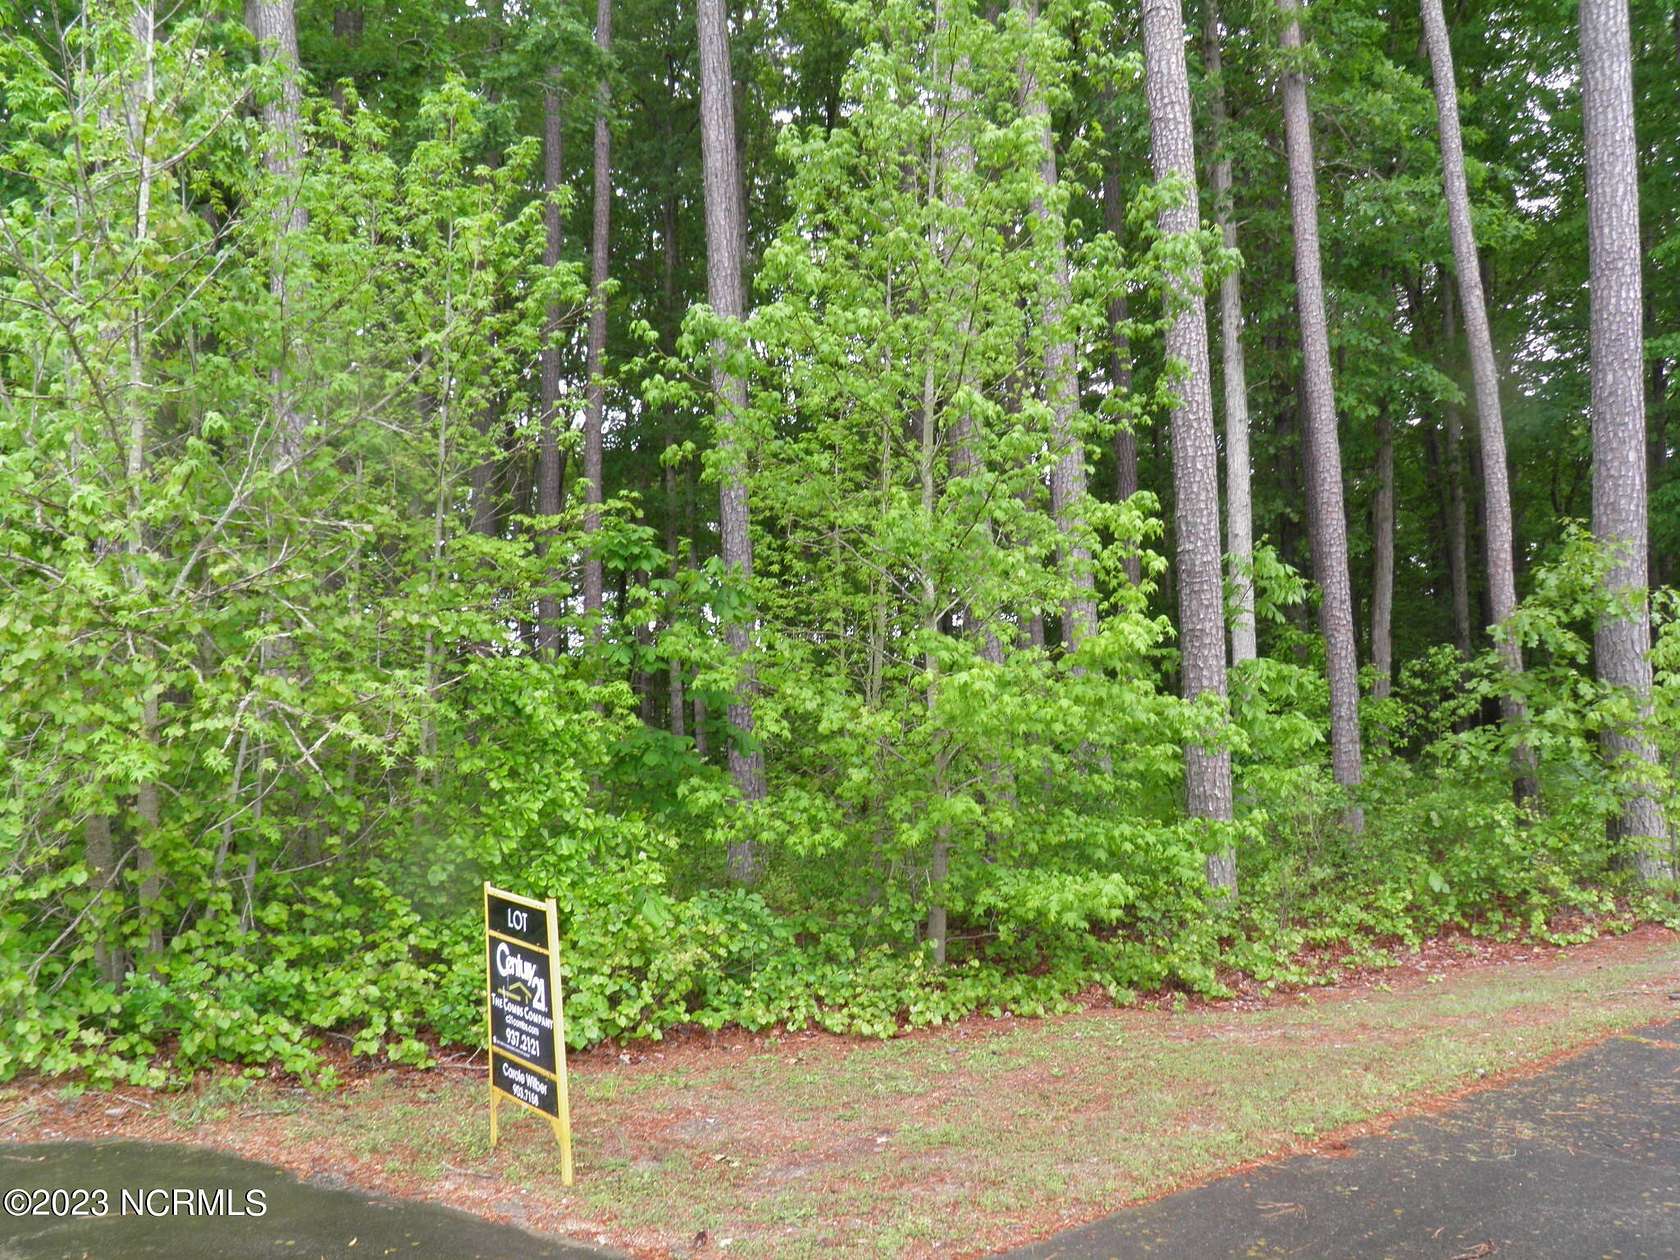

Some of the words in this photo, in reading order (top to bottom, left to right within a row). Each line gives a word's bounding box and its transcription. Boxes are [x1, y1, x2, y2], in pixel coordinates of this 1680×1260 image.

[507, 907, 529, 932] LOT
[496, 942, 537, 987] Century
[531, 976, 546, 1012] 21
[491, 992, 504, 1008] THE
[523, 1006, 553, 1030] COMPANY
[505, 1027, 540, 1057] 937.2121
[502, 1062, 526, 1085] Carole
[525, 1072, 548, 1096] Wilber
